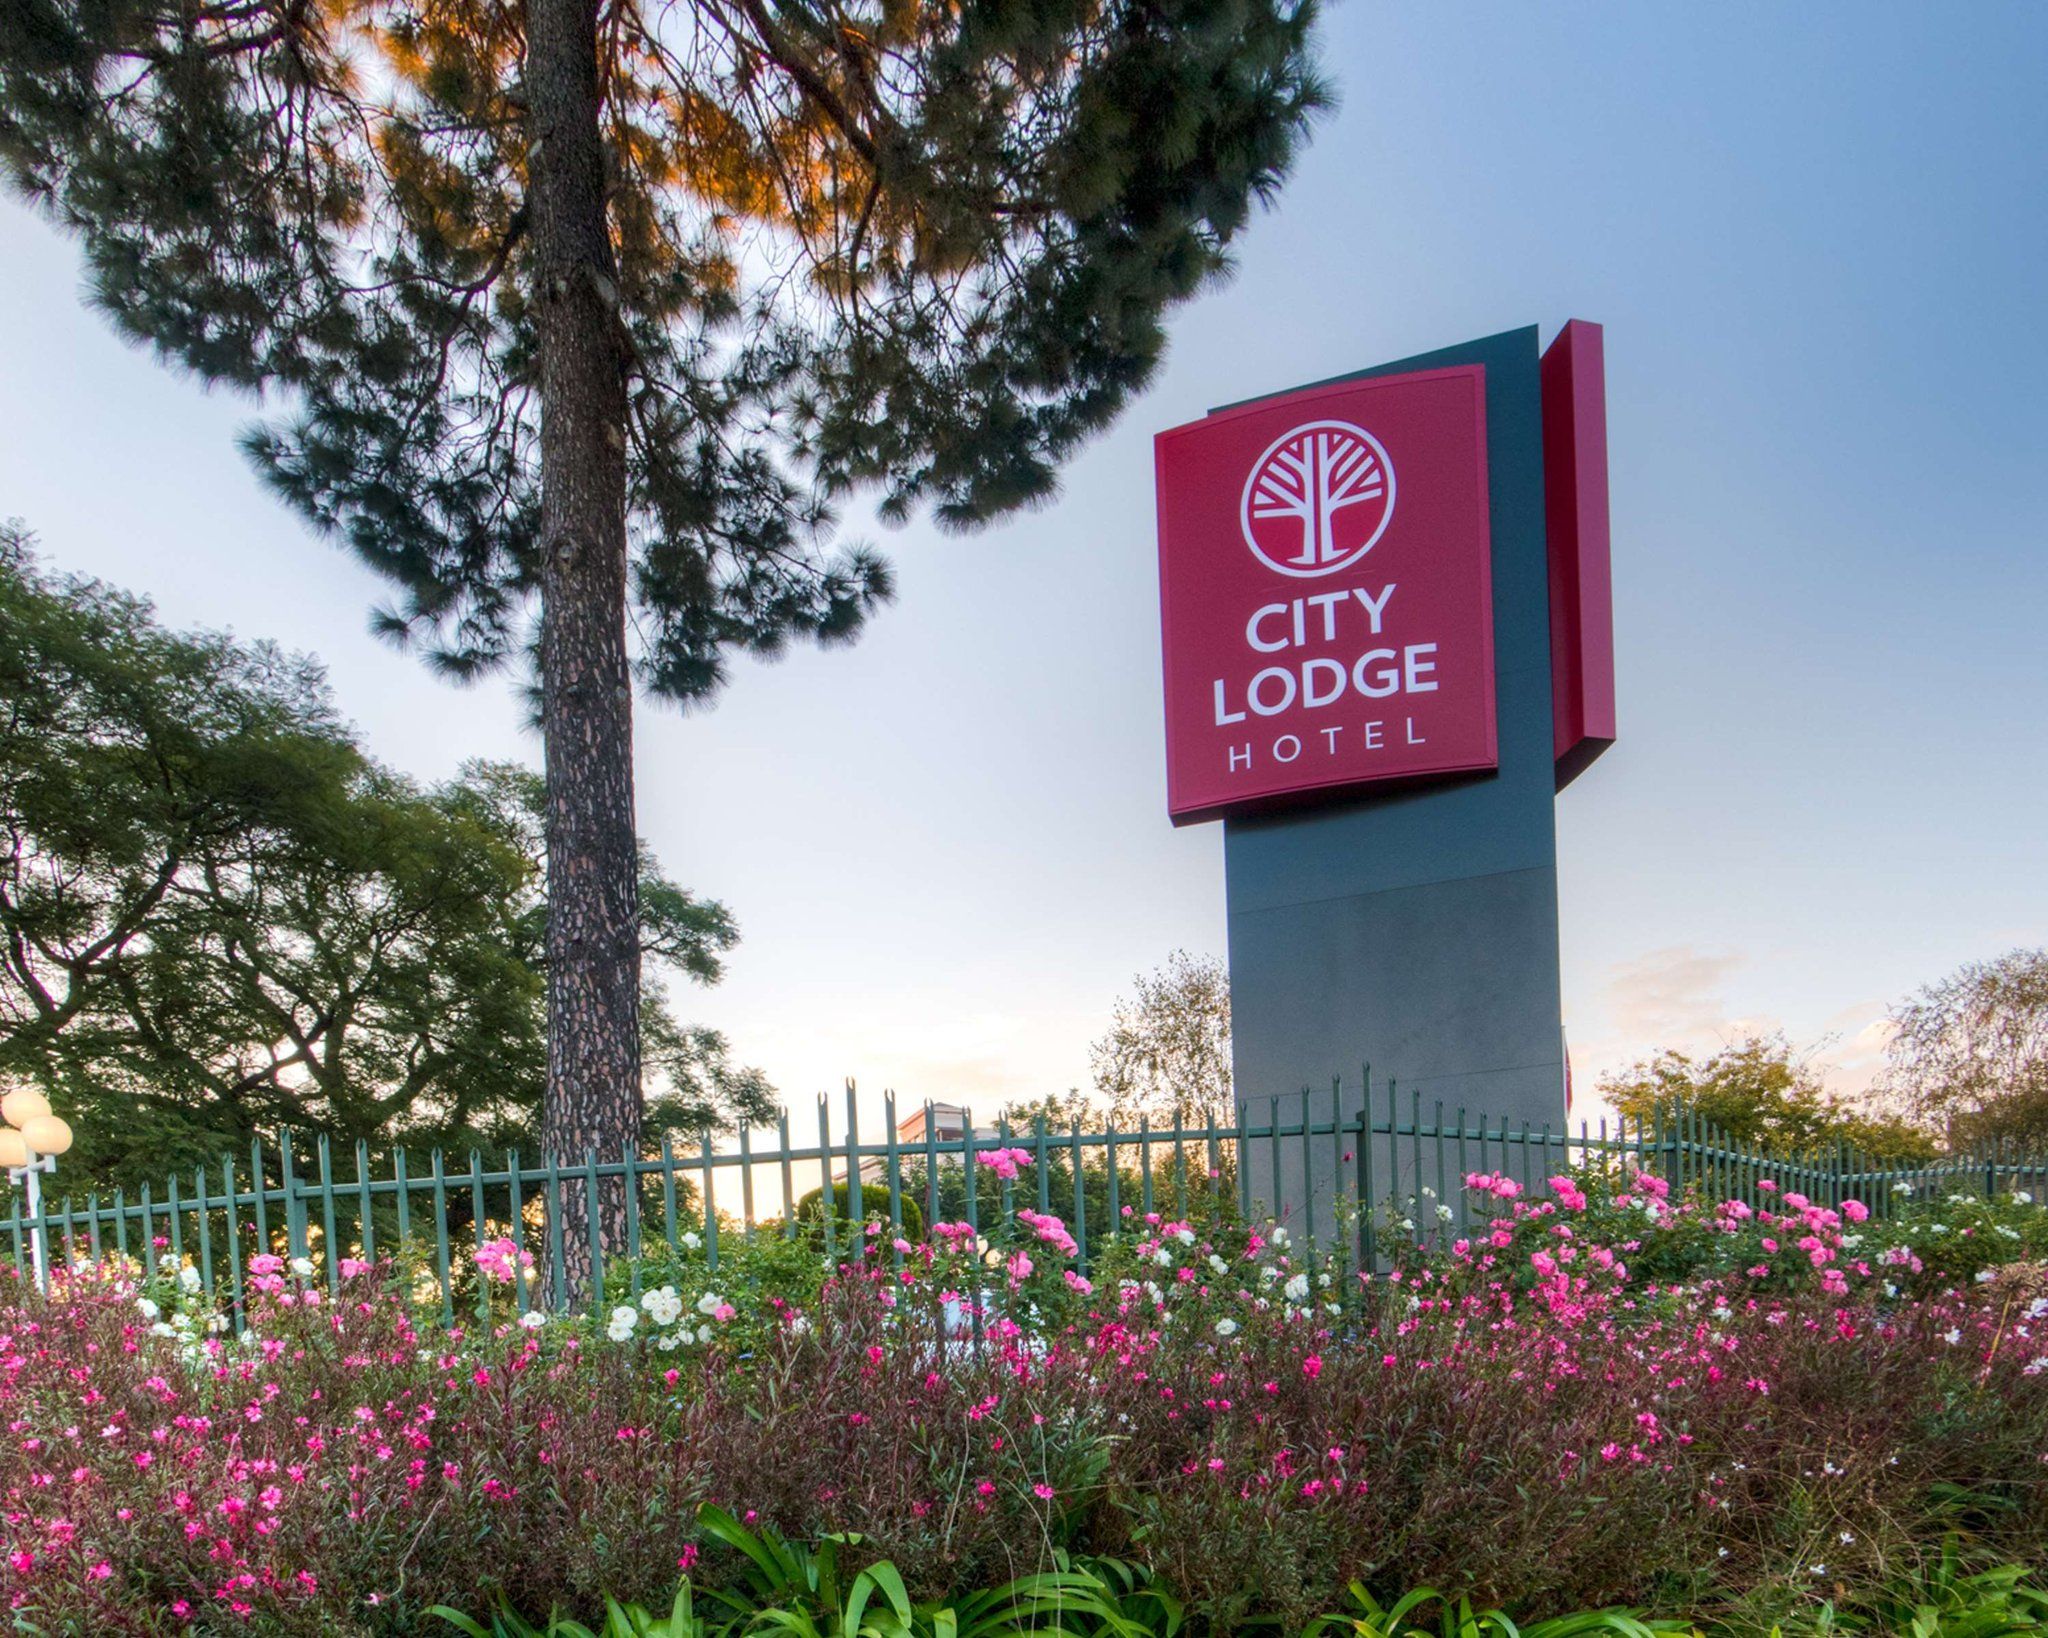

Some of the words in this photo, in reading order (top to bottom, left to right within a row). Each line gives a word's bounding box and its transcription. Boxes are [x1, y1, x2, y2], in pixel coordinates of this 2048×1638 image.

[1245, 583, 1397, 653] CITY
[1213, 642, 1439, 727] LODGE
[1228, 717, 1426, 773] HOTEL
